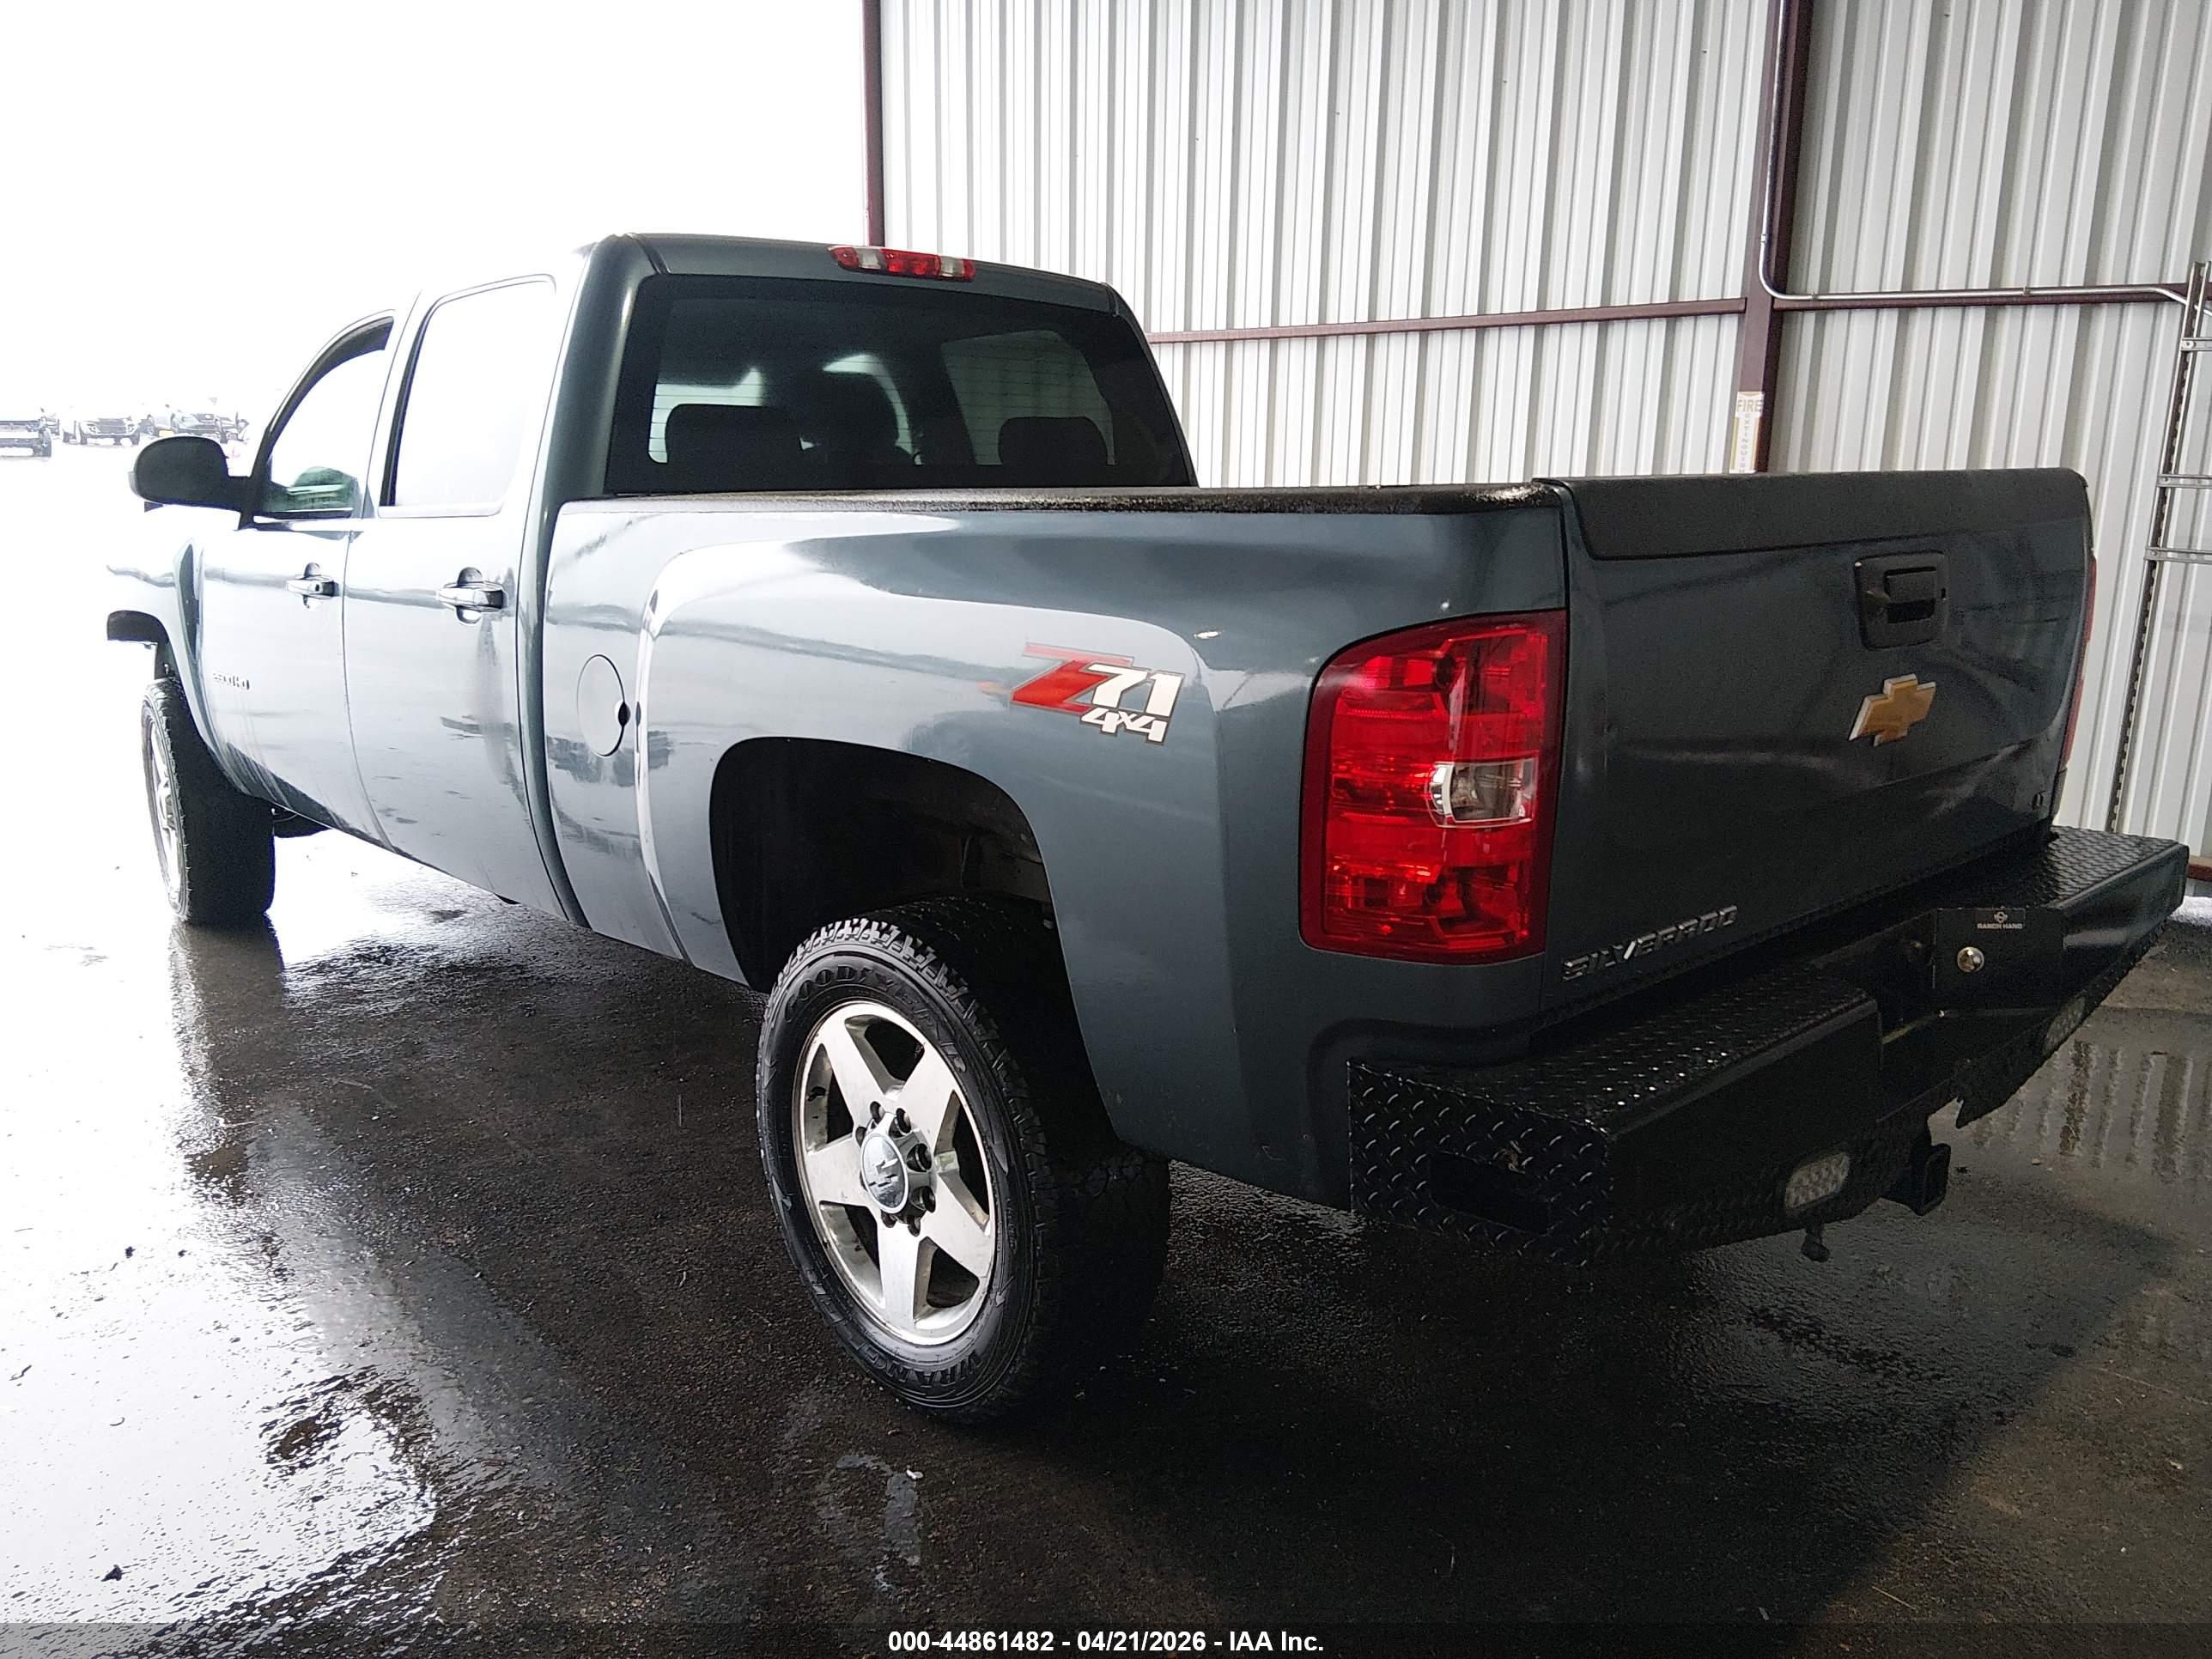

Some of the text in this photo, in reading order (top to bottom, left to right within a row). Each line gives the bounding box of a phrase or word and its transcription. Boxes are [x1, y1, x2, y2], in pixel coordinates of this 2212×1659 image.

[1736, 399, 1763, 412] FIRE
[1010, 642, 1186, 718] Z71
[1561, 904, 1738, 981] SILVERADO
[784, 963, 967, 1073] GOODYEAR
